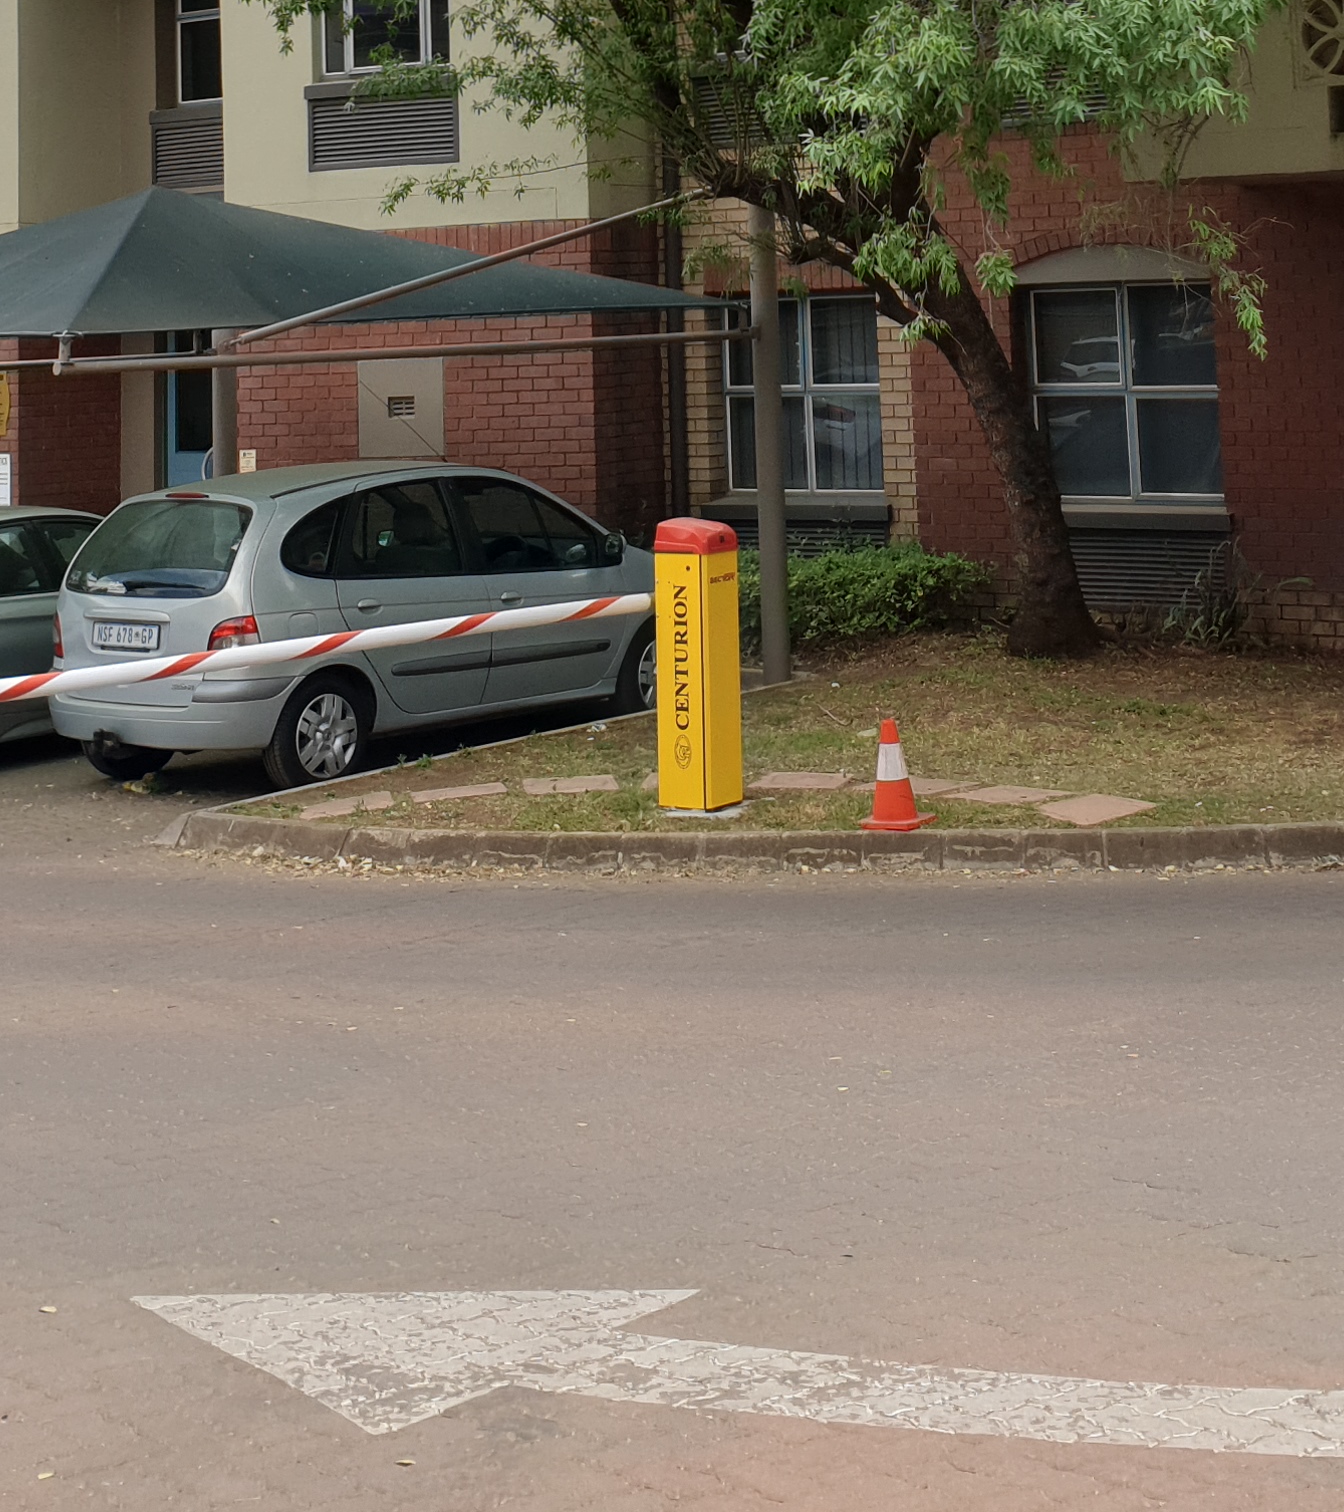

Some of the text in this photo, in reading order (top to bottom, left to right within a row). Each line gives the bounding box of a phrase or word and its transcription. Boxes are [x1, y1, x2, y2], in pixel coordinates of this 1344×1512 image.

[97, 625, 154, 644] NSF 678 GP
[673, 584, 690, 730] CENTURION
